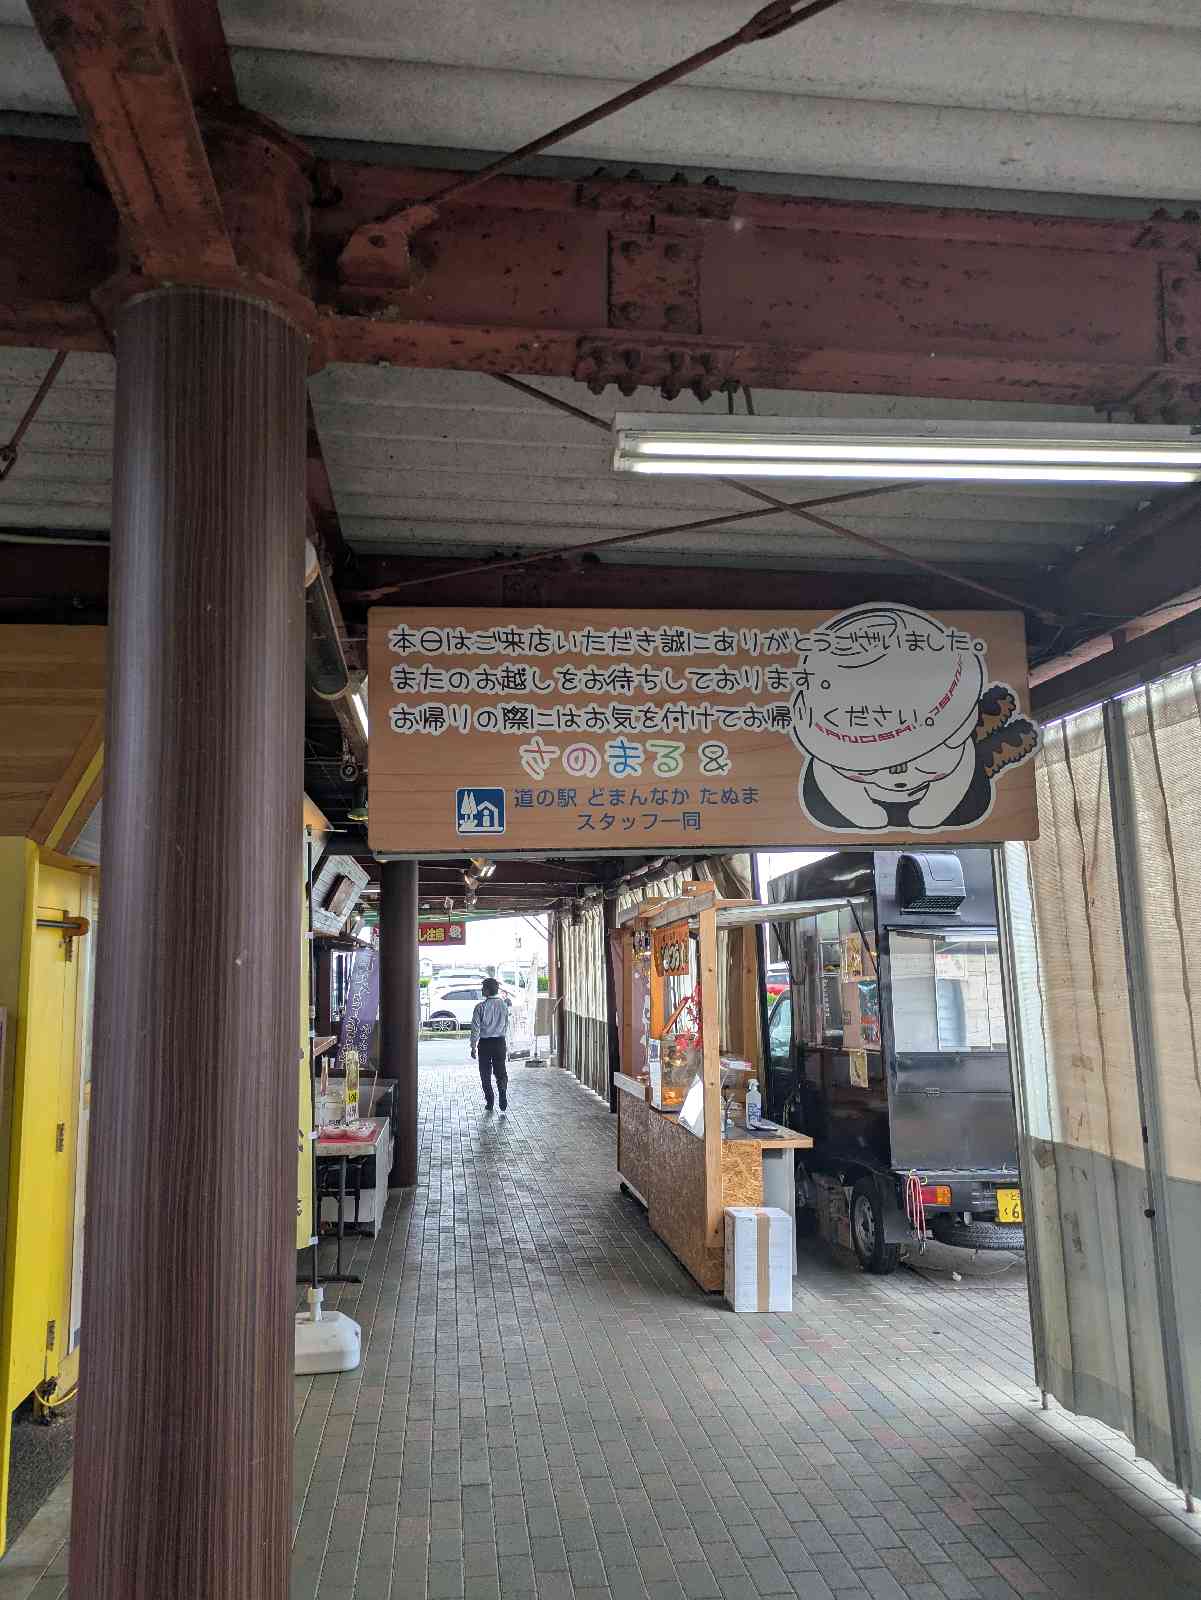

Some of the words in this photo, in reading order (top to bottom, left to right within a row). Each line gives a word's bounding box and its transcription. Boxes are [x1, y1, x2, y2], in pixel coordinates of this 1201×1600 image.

[391, 628, 985, 653] 本日はご来店いただき誠にありがとうございました。
[393, 667, 832, 692] またのお越しをお待ちしております。
[393, 705, 935, 730] お帰りの際にはお気を付けてお帰りください。
[521, 739, 683, 777] さのまる
[700, 742, 730, 774] &
[514, 788, 578, 809] 道の駅
[587, 787, 690, 808] どまんなか
[699, 786, 760, 806] たぬま
[577, 811, 701, 831] スタッフ一同
